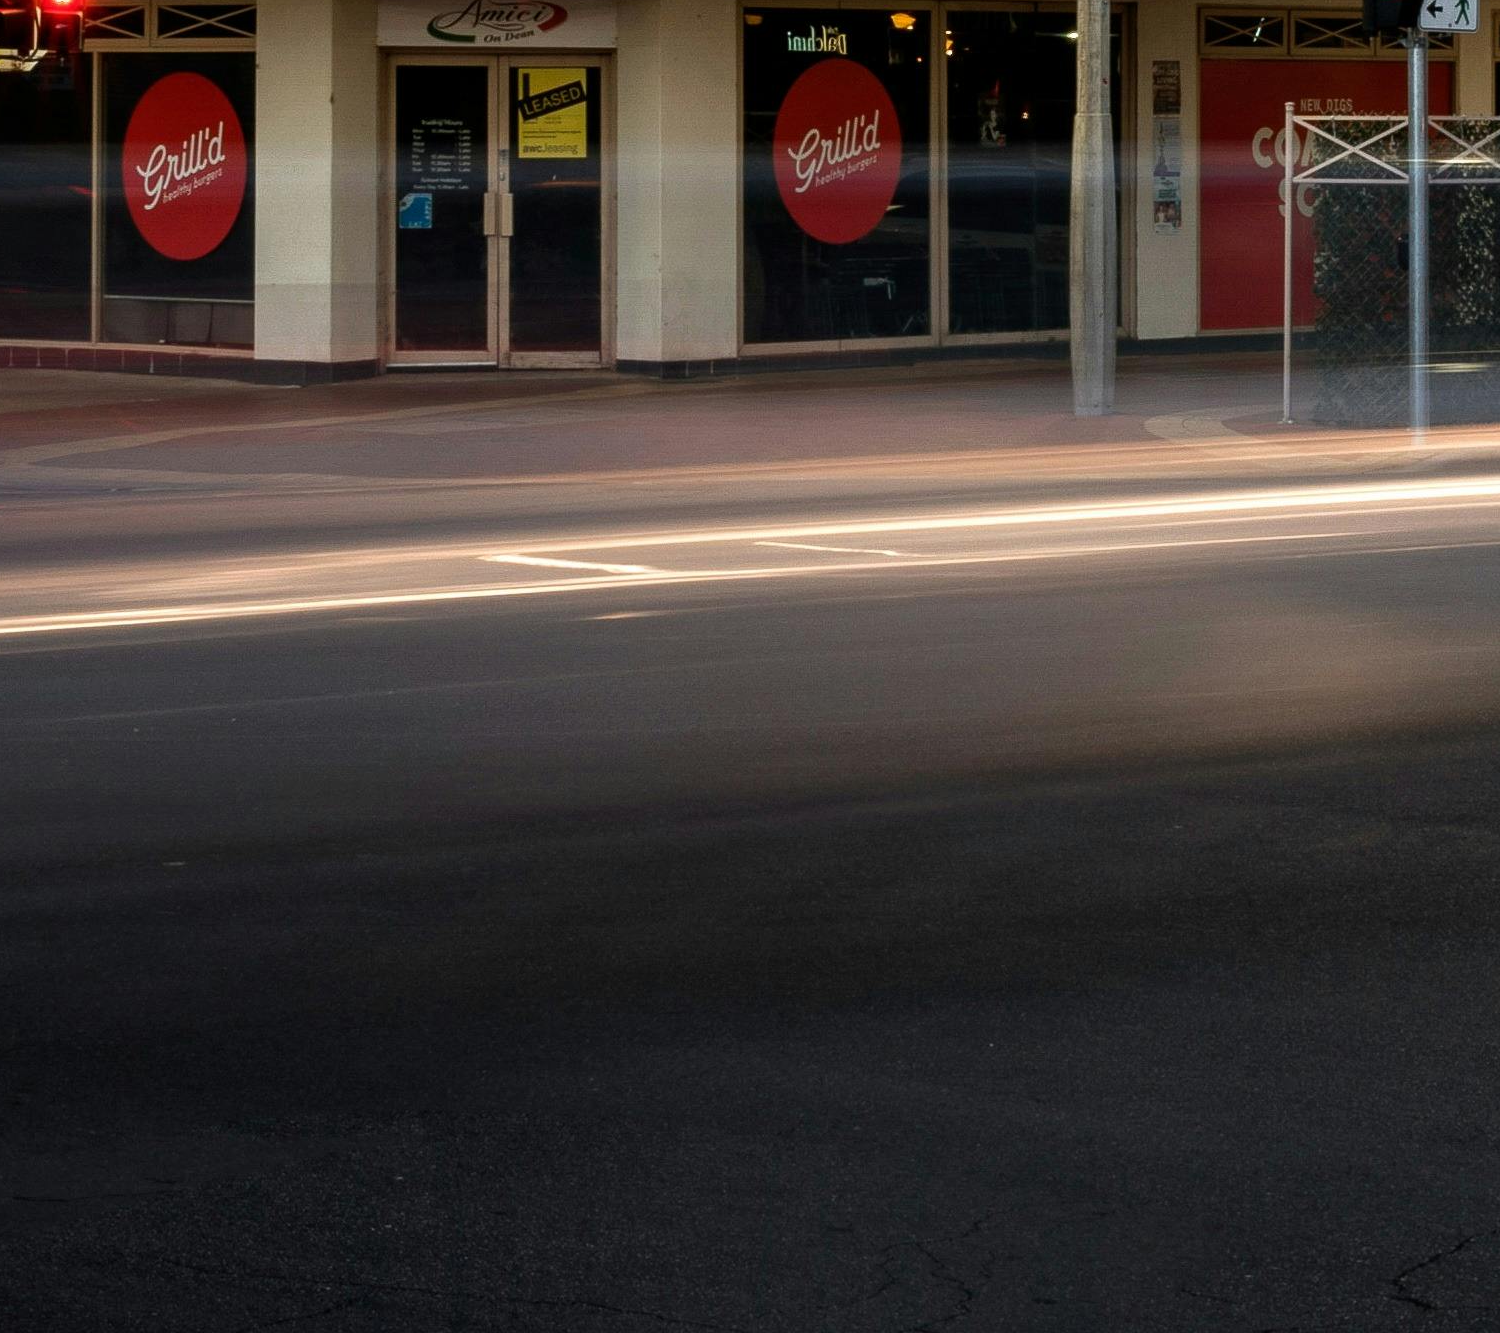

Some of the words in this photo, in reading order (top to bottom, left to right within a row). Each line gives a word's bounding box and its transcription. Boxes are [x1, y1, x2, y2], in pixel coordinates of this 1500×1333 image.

[483, 34, 501, 44] On
[505, 30, 536, 43] Dean
[524, 86, 581, 116] LEASED
[1301, 99, 1320, 111] NEW
[1327, 98, 1353, 111] DIGS
[137, 121, 226, 210] Grill'd
[788, 109, 881, 193] Grill'd
